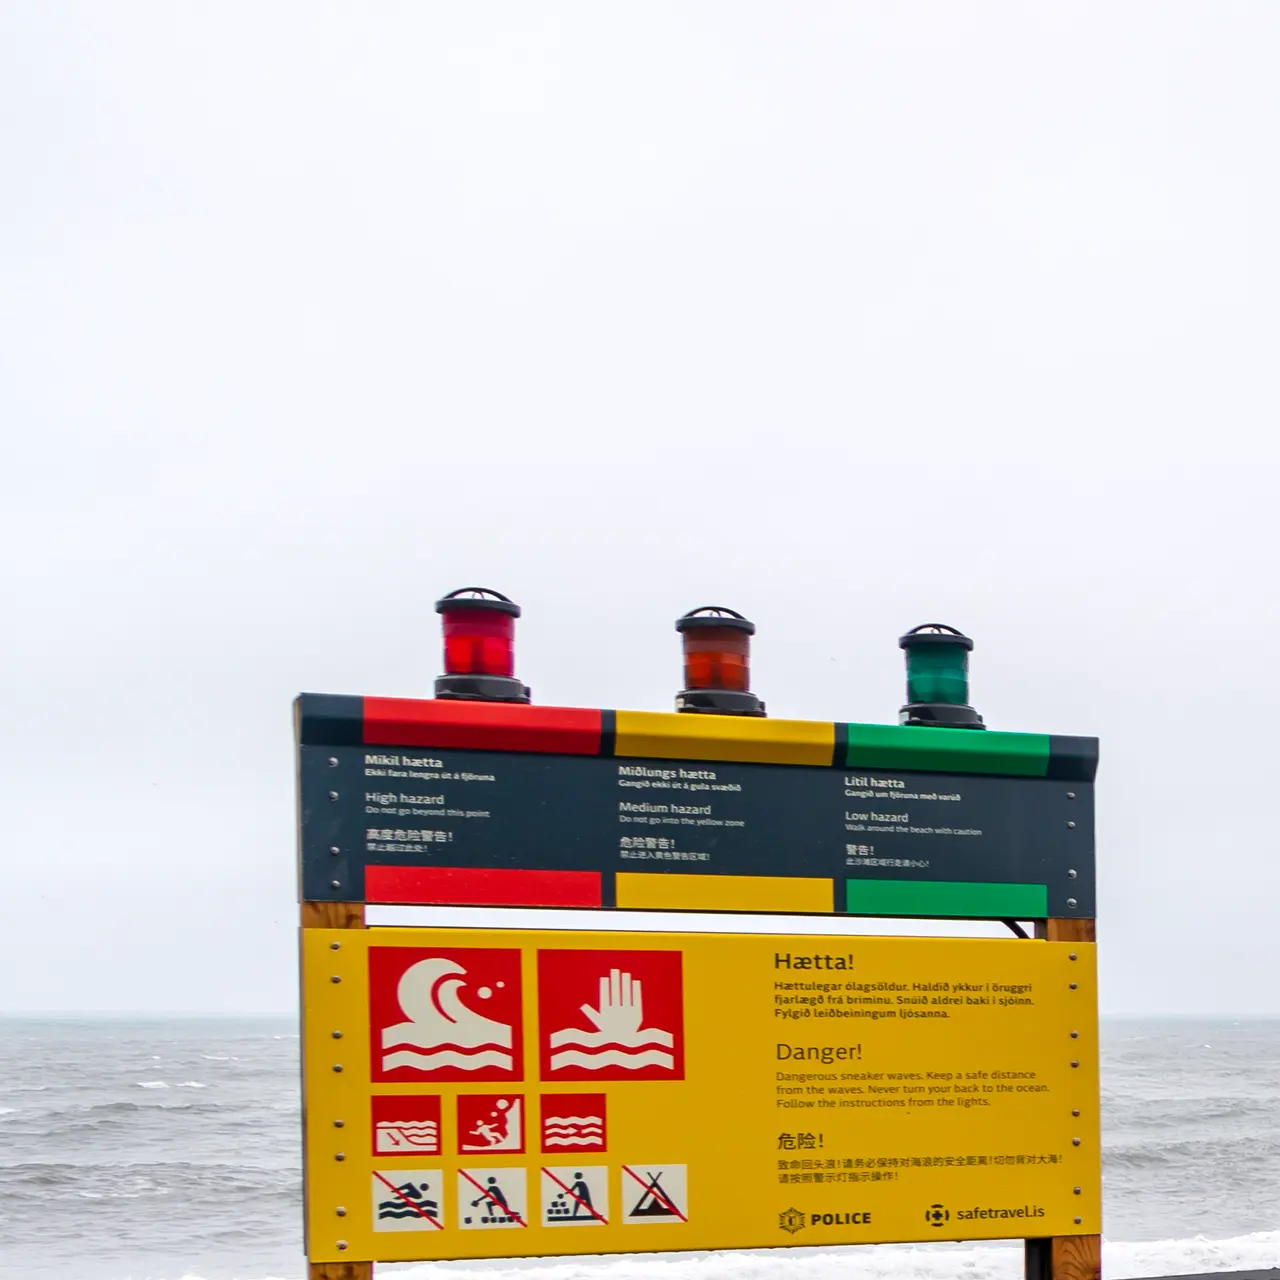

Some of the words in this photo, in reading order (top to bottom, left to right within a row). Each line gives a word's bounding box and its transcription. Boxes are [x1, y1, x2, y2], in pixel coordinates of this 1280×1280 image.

[365, 755, 400, 766] Mikil
[402, 756, 443, 767] hætta
[388, 769, 408, 777] fara
[619, 766, 677, 780] Miðlungs
[679, 769, 716, 780] hætta
[618, 780, 650, 789] Gangið
[690, 783, 710, 791] gula
[870, 778, 905, 788] hætta
[366, 792, 397, 805] High
[400, 793, 444, 804] hazard
[845, 789, 874, 798] Gangið
[412, 808, 445, 816] beyond
[619, 802, 668, 812] Medium
[671, 804, 711, 814] hazard
[696, 818, 723, 826] yellow
[846, 811, 868, 820] Low
[871, 812, 908, 822] hazard
[775, 953, 853, 970] Hætta!
[774, 982, 842, 993] Hættulegar
[845, 982, 910, 993] ólagsöldur.
[913, 983, 949, 991] Haldið
[952, 983, 983, 993] ykkur
[992, 983, 1032, 994] öruggri
[775, 995, 824, 1006] fjarlægð
[827, 995, 843, 1004] frá
[847, 996, 893, 1004] briminu.
[931, 996, 963, 1005] aldrei
[966, 996, 989, 1005] baki
[774, 1008, 811, 1020] Fylgið
[814, 1008, 896, 1020] leiðbeiningum
[900, 1009, 950, 1019] ljósanna.
[777, 1044, 861, 1064] Danger!
[776, 1072, 838, 1083] Dangerous
[840, 1072, 884, 1080] sneaker
[887, 1072, 924, 1080] waves.
[926, 1072, 953, 1081] Keep
[965, 1071, 988, 1080] safe
[991, 1070, 1036, 1079] distance
[776, 1085, 803, 1094] from
[806, 1085, 824, 1095] the
[828, 1087, 865, 1095] waves.
[868, 1085, 900, 1094] Never
[928, 1086, 951, 1095] your
[954, 1084, 980, 1093] back
[996, 1084, 1014, 1092] the
[776, 1099, 815, 1108] Follow
[817, 1099, 836, 1107] the
[839, 1099, 905, 1107] instructions
[908, 1098, 934, 1106] from
[937, 1098, 955, 1106] the
[957, 1097, 991, 1108] lights.
[778, 1133, 823, 1150] 危险!
[811, 1213, 871, 1225] POLICE
[957, 1206, 1044, 1220] safetravel.is
